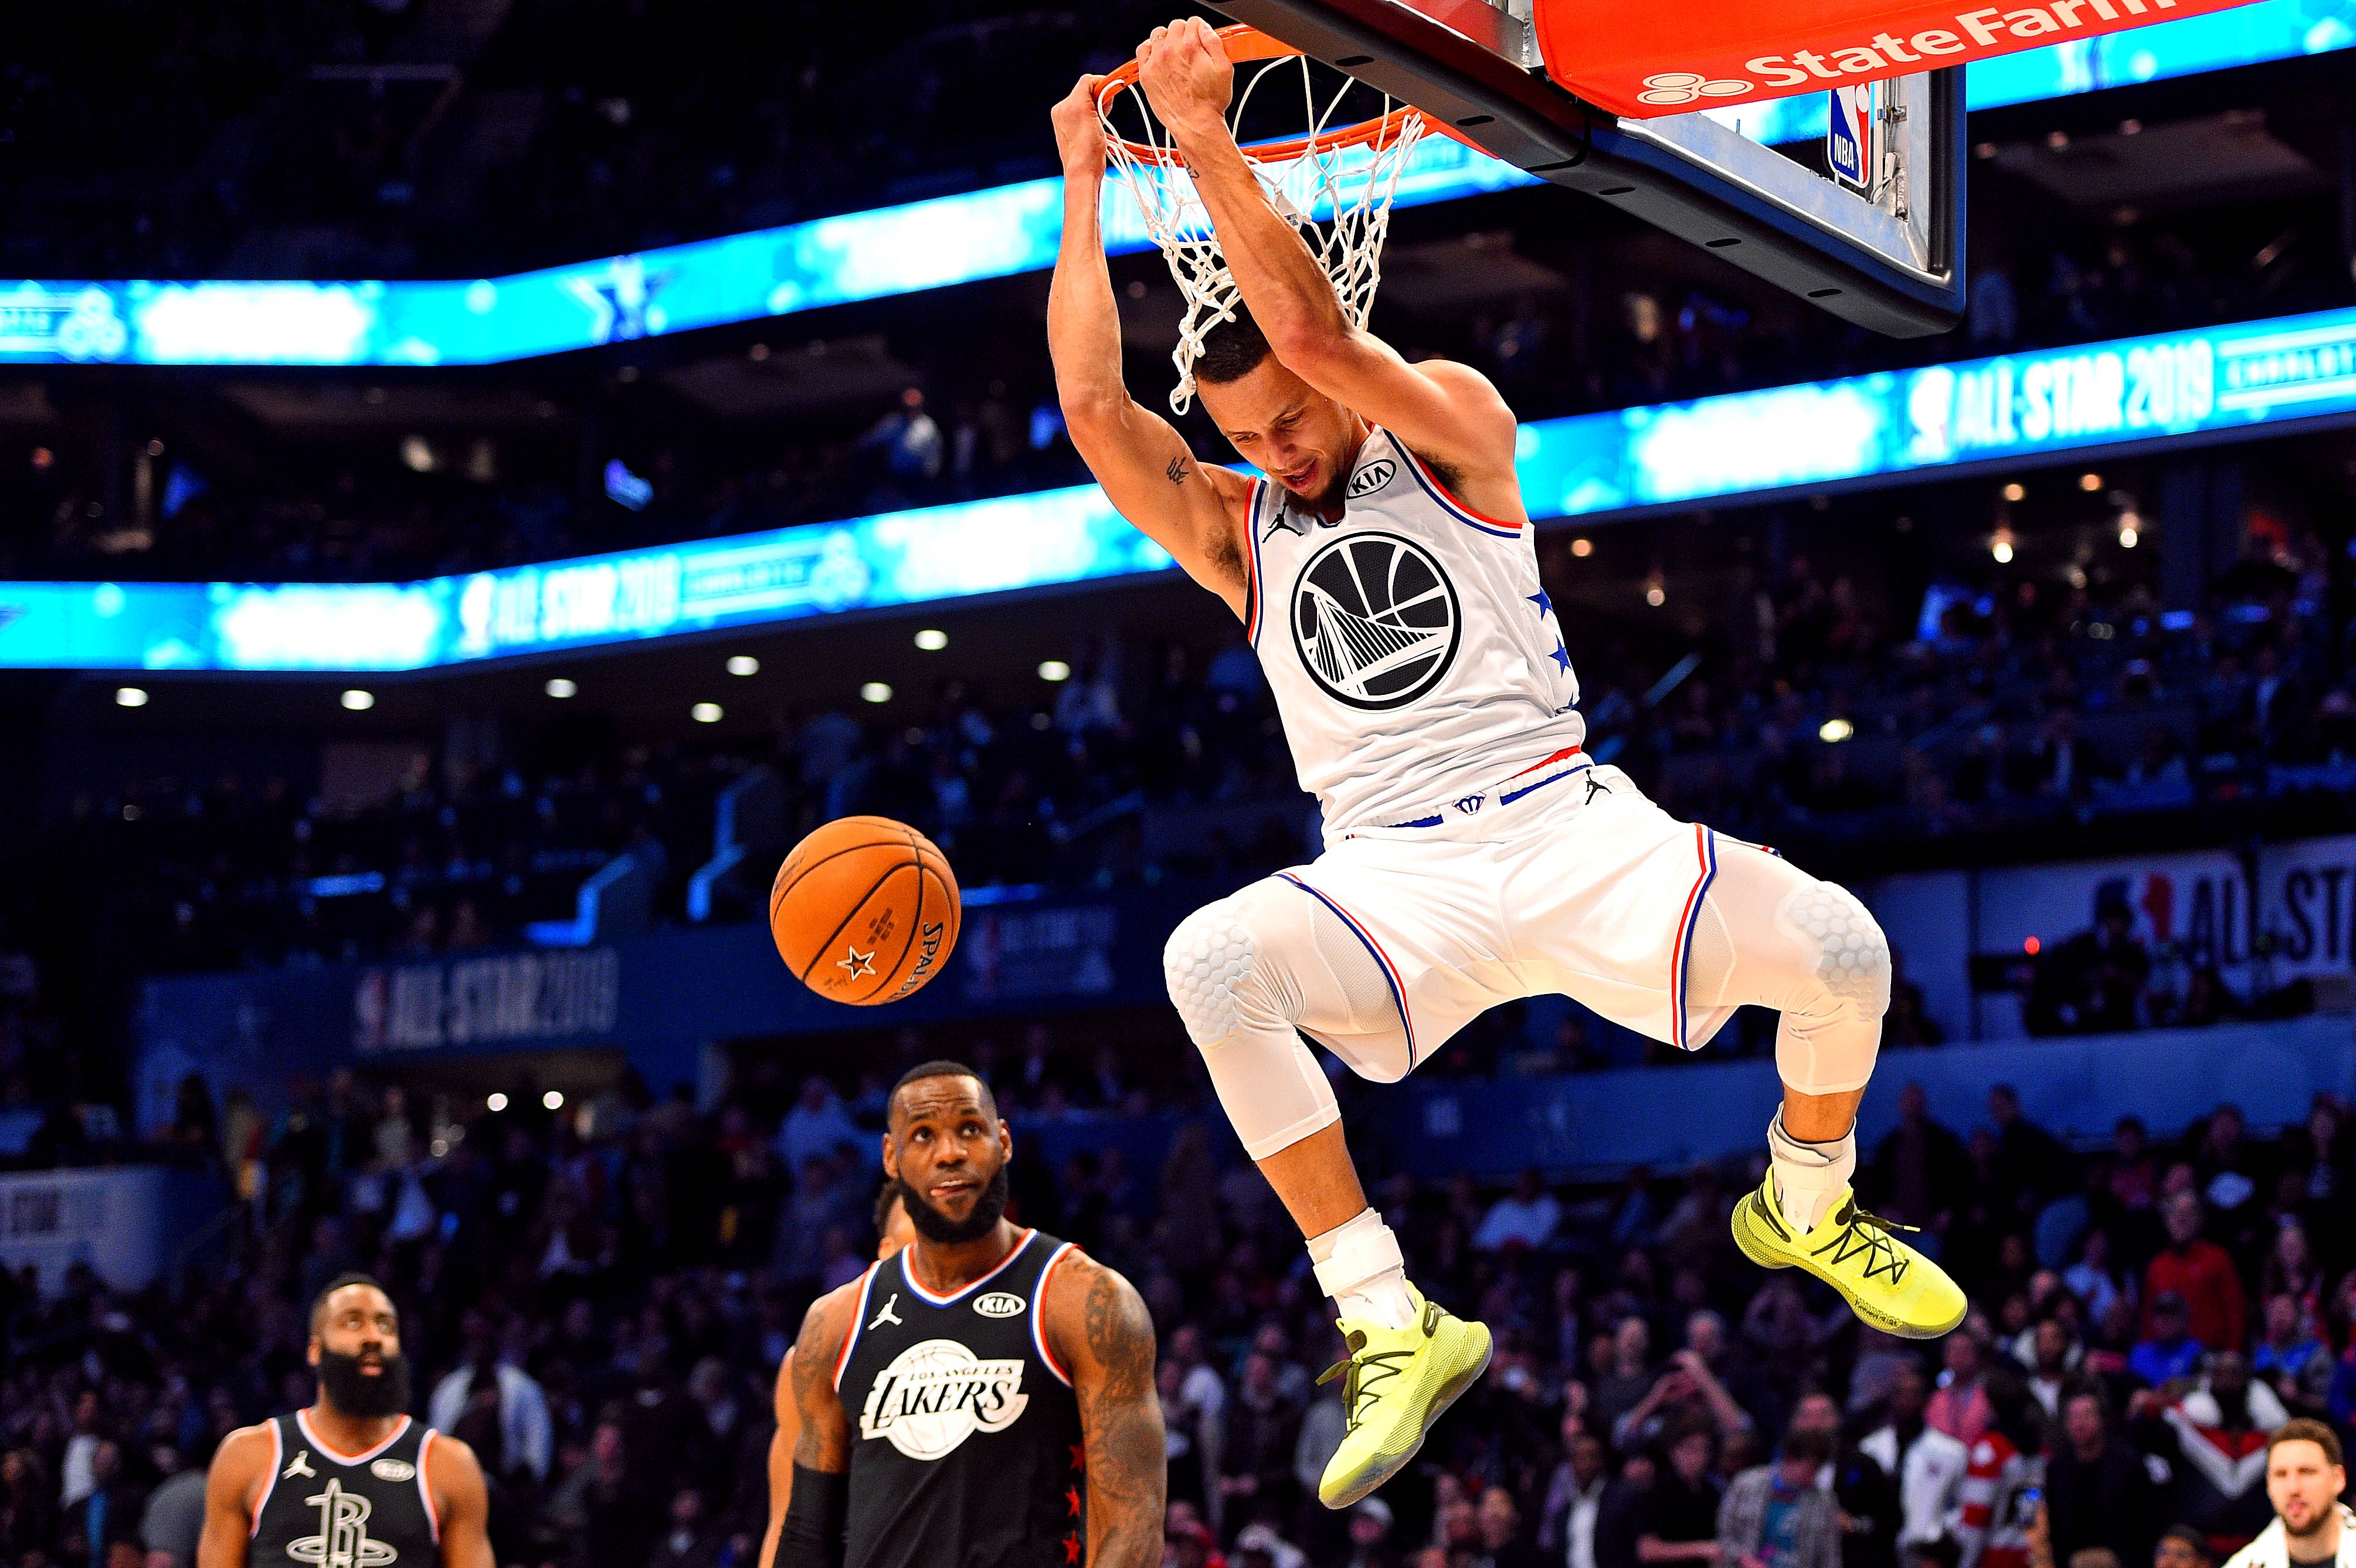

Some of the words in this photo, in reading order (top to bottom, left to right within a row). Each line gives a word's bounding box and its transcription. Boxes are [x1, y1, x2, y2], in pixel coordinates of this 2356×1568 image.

[1834, 133, 1855, 171] NBA
[2126, 338, 2214, 427] 2019
[1352, 466, 1390, 494] KIA
[982, 1297, 1016, 1313] KIA
[873, 1375, 1017, 1430] LAKERS
